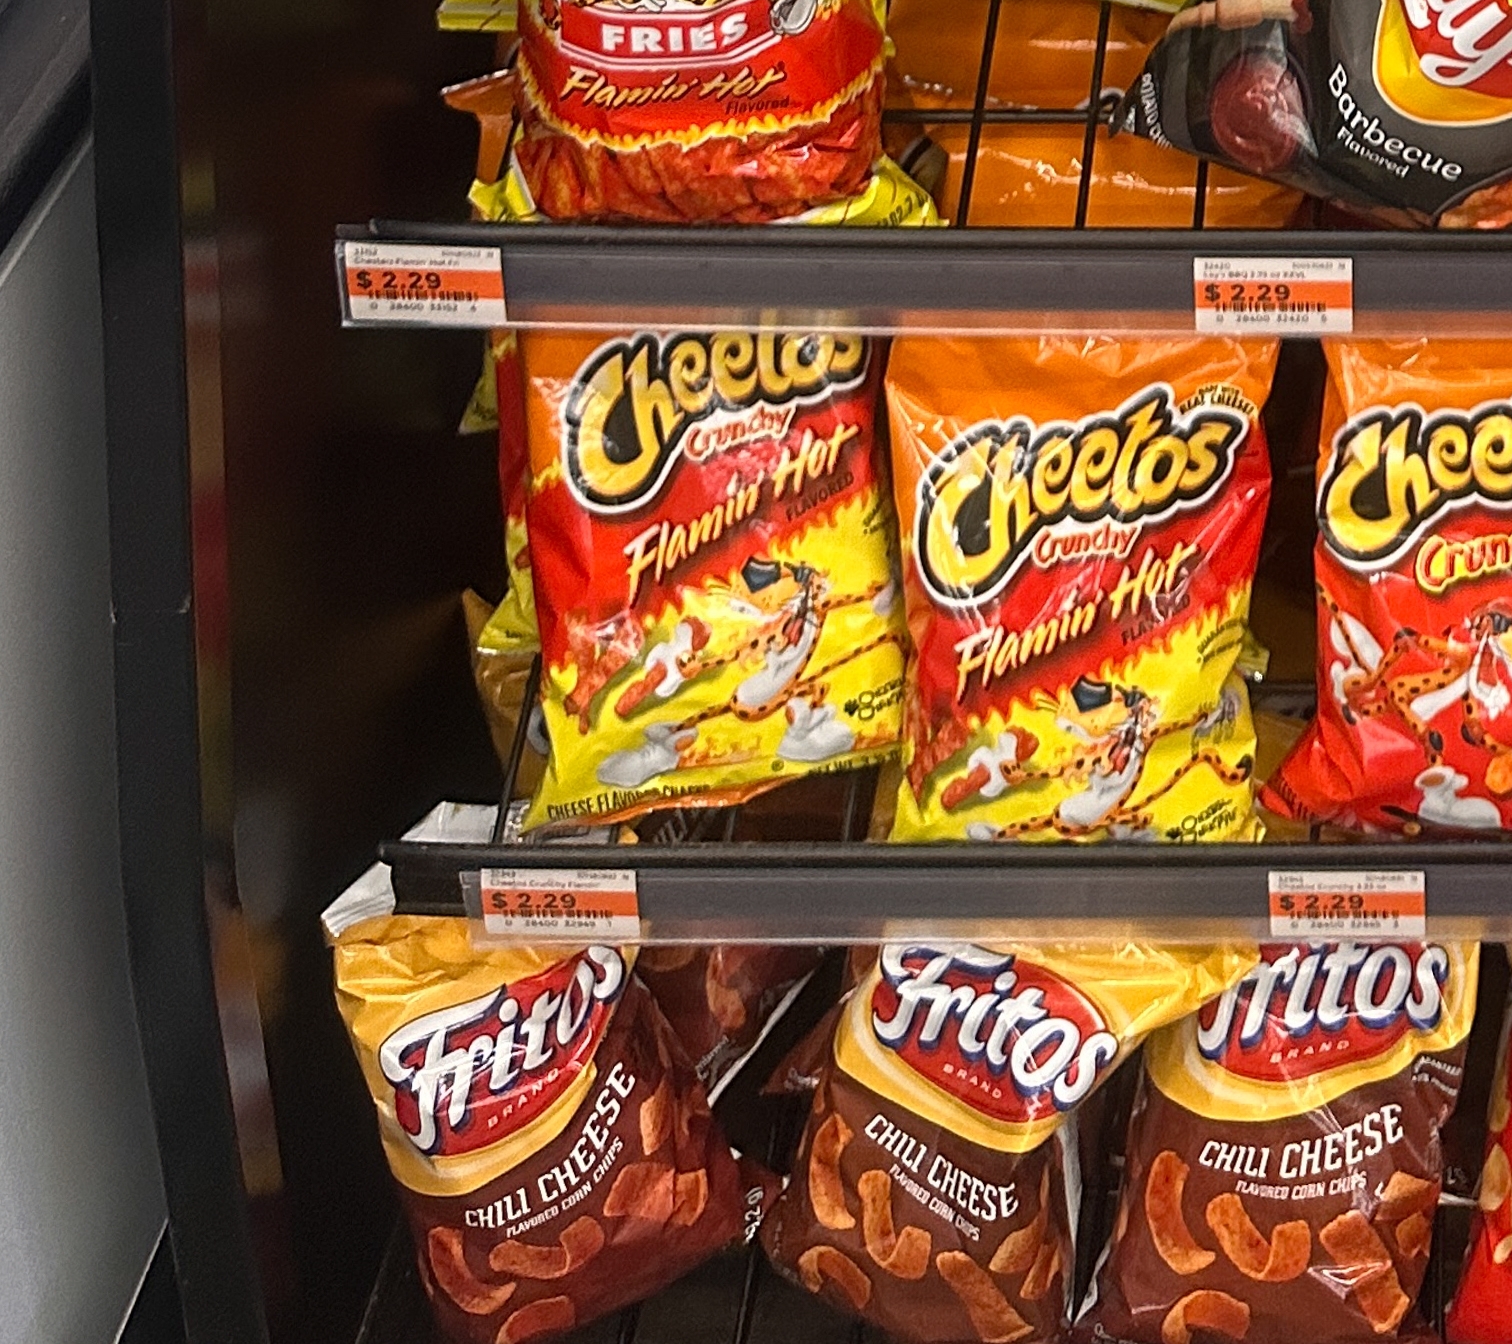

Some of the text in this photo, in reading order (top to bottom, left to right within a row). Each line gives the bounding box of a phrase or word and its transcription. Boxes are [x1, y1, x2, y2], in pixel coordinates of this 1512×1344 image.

[602, 13, 747, 53] FRIES
[700, 67, 784, 100] Hot
[1328, 64, 1463, 182] Barbecue
[1231, 284, 1290, 301] 2.29
[685, 401, 793, 460] Crunchy
[773, 423, 859, 497] Hot
[926, 398, 1233, 593] Cheetos
[1111, 543, 1197, 618] Hot
[380, 945, 623, 1151] Fritos
[873, 944, 1118, 1104] Fritos
[465, 1061, 636, 1229] CHILI CHEESE
[1199, 1104, 1403, 1179] CHILI CHEESE
[1236, 1171, 1367, 1200] FLAVORED CORN CHIPS
